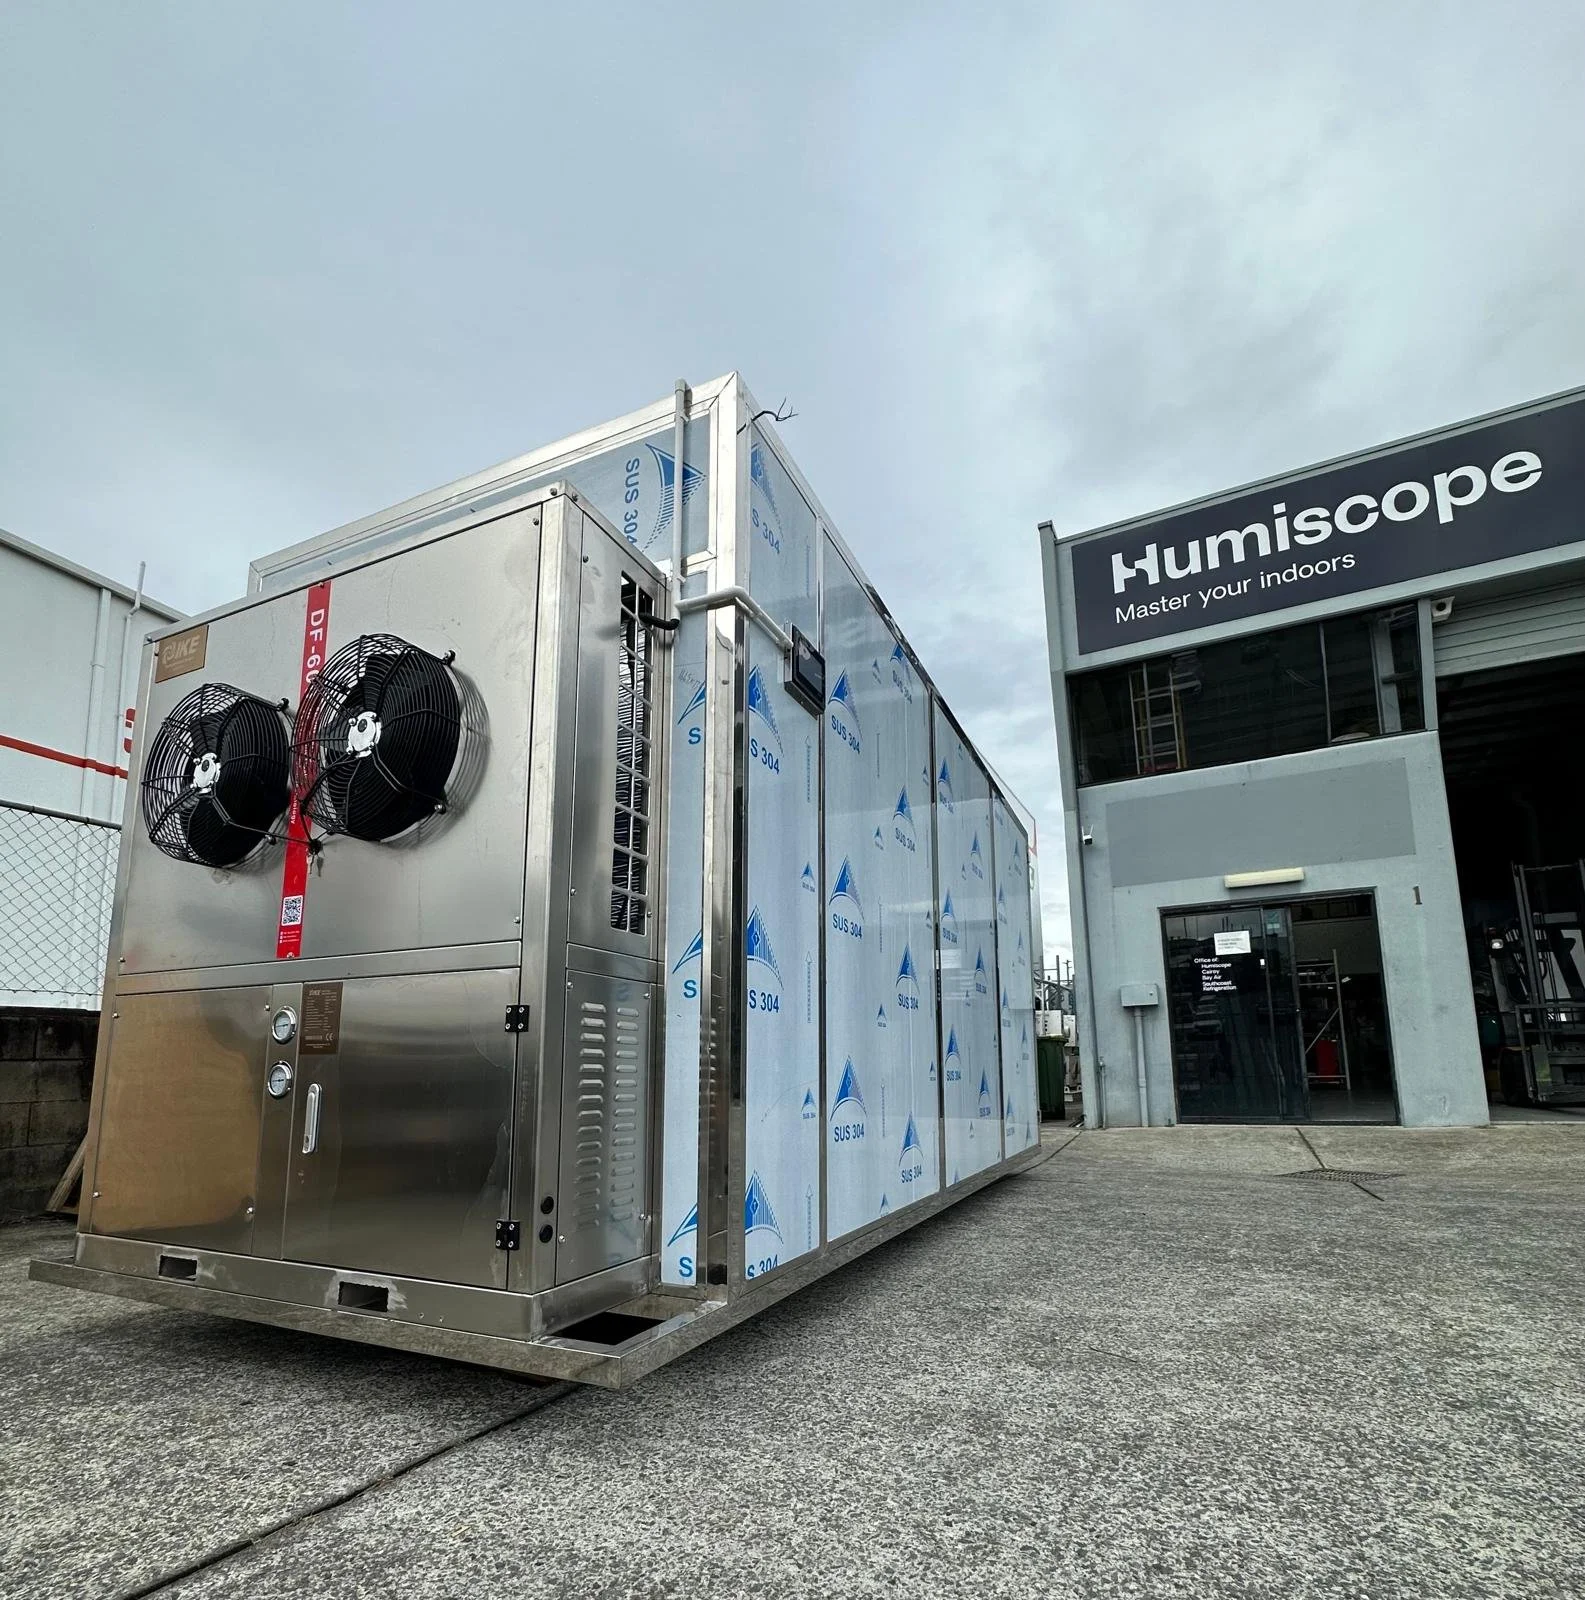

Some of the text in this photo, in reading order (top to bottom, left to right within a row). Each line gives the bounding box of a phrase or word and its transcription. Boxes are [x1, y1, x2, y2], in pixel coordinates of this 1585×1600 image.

[623, 458, 640, 544] SUS 304
[1111, 450, 1543, 594] Humiscope
[763, 522, 780, 555] 304
[1115, 551, 1356, 624] Master your indoors
[688, 727, 702, 745] S
[831, 714, 861, 755] SUS 304
[761, 747, 780, 775] 304
[1412, 885, 1423, 905] 1
[832, 913, 863, 939] SUS 304
[683, 979, 697, 998] S
[747, 989, 780, 1013] S 304
[897, 993, 919, 1010] SUS 304
[834, 1123, 865, 1143] SUS 304
[901, 1165, 922, 1183] SUS 304
[679, 1256, 693, 1277] S
